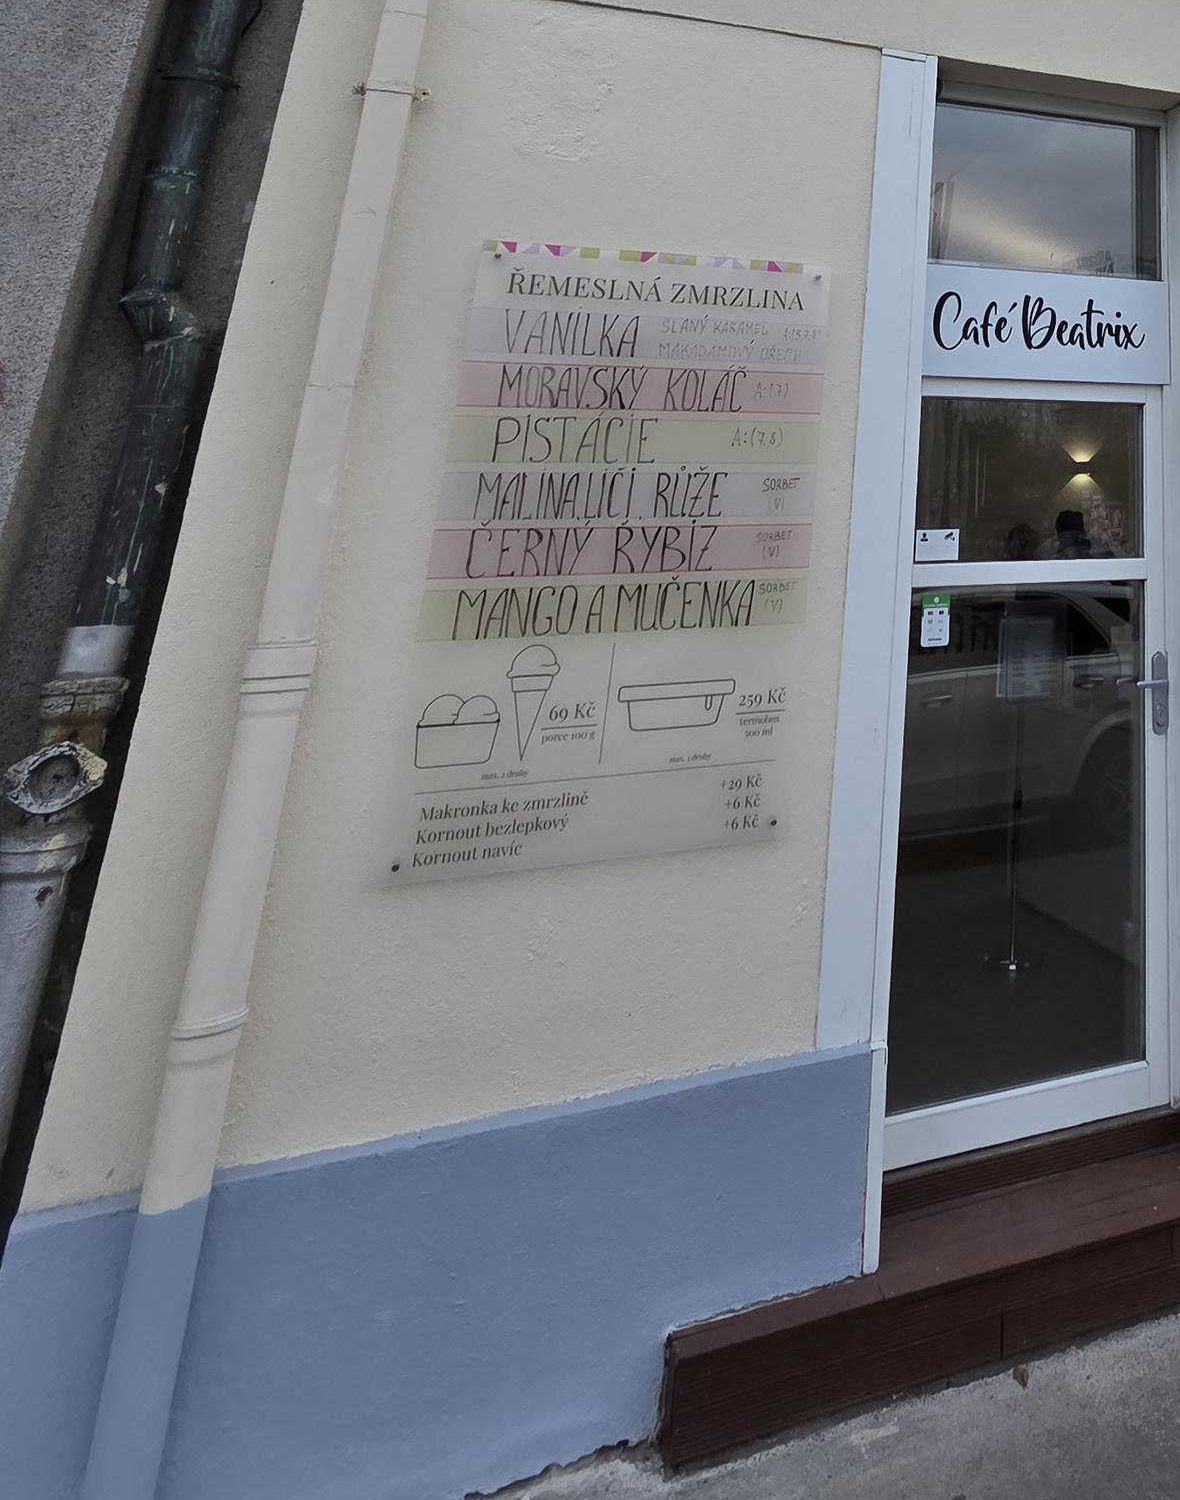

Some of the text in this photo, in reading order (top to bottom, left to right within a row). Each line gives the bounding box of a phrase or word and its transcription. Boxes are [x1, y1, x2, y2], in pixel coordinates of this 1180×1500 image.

[506, 267, 804, 311] ŘEMESLNÁ ZMRZLINA
[932, 291, 1146, 351] Café Beatrix
[497, 364, 748, 414] MORAVSKÝ KOLÁČ
[491, 411, 659, 464] PISTÁCIE
[653, 465, 729, 519] RŮŽE
[761, 477, 801, 493] SORBET
[465, 519, 595, 580] ČERNÝ
[754, 529, 794, 544] SORBET
[761, 544, 781, 560] (V)
[451, 575, 756, 642] MANGO A MUČENKA
[548, 700, 597, 723] 69 Kč
[738, 686, 787, 708] 259 Kč
[720, 773, 763, 792] +29 Kč
[418, 790, 590, 822] Makronka ke zmrzlině
[723, 793, 762, 810] +6 Kč
[415, 813, 570, 846] Kornout bezlepkový
[721, 813, 760, 831] +6 Kč
[411, 839, 523, 868] Kornout navíc
